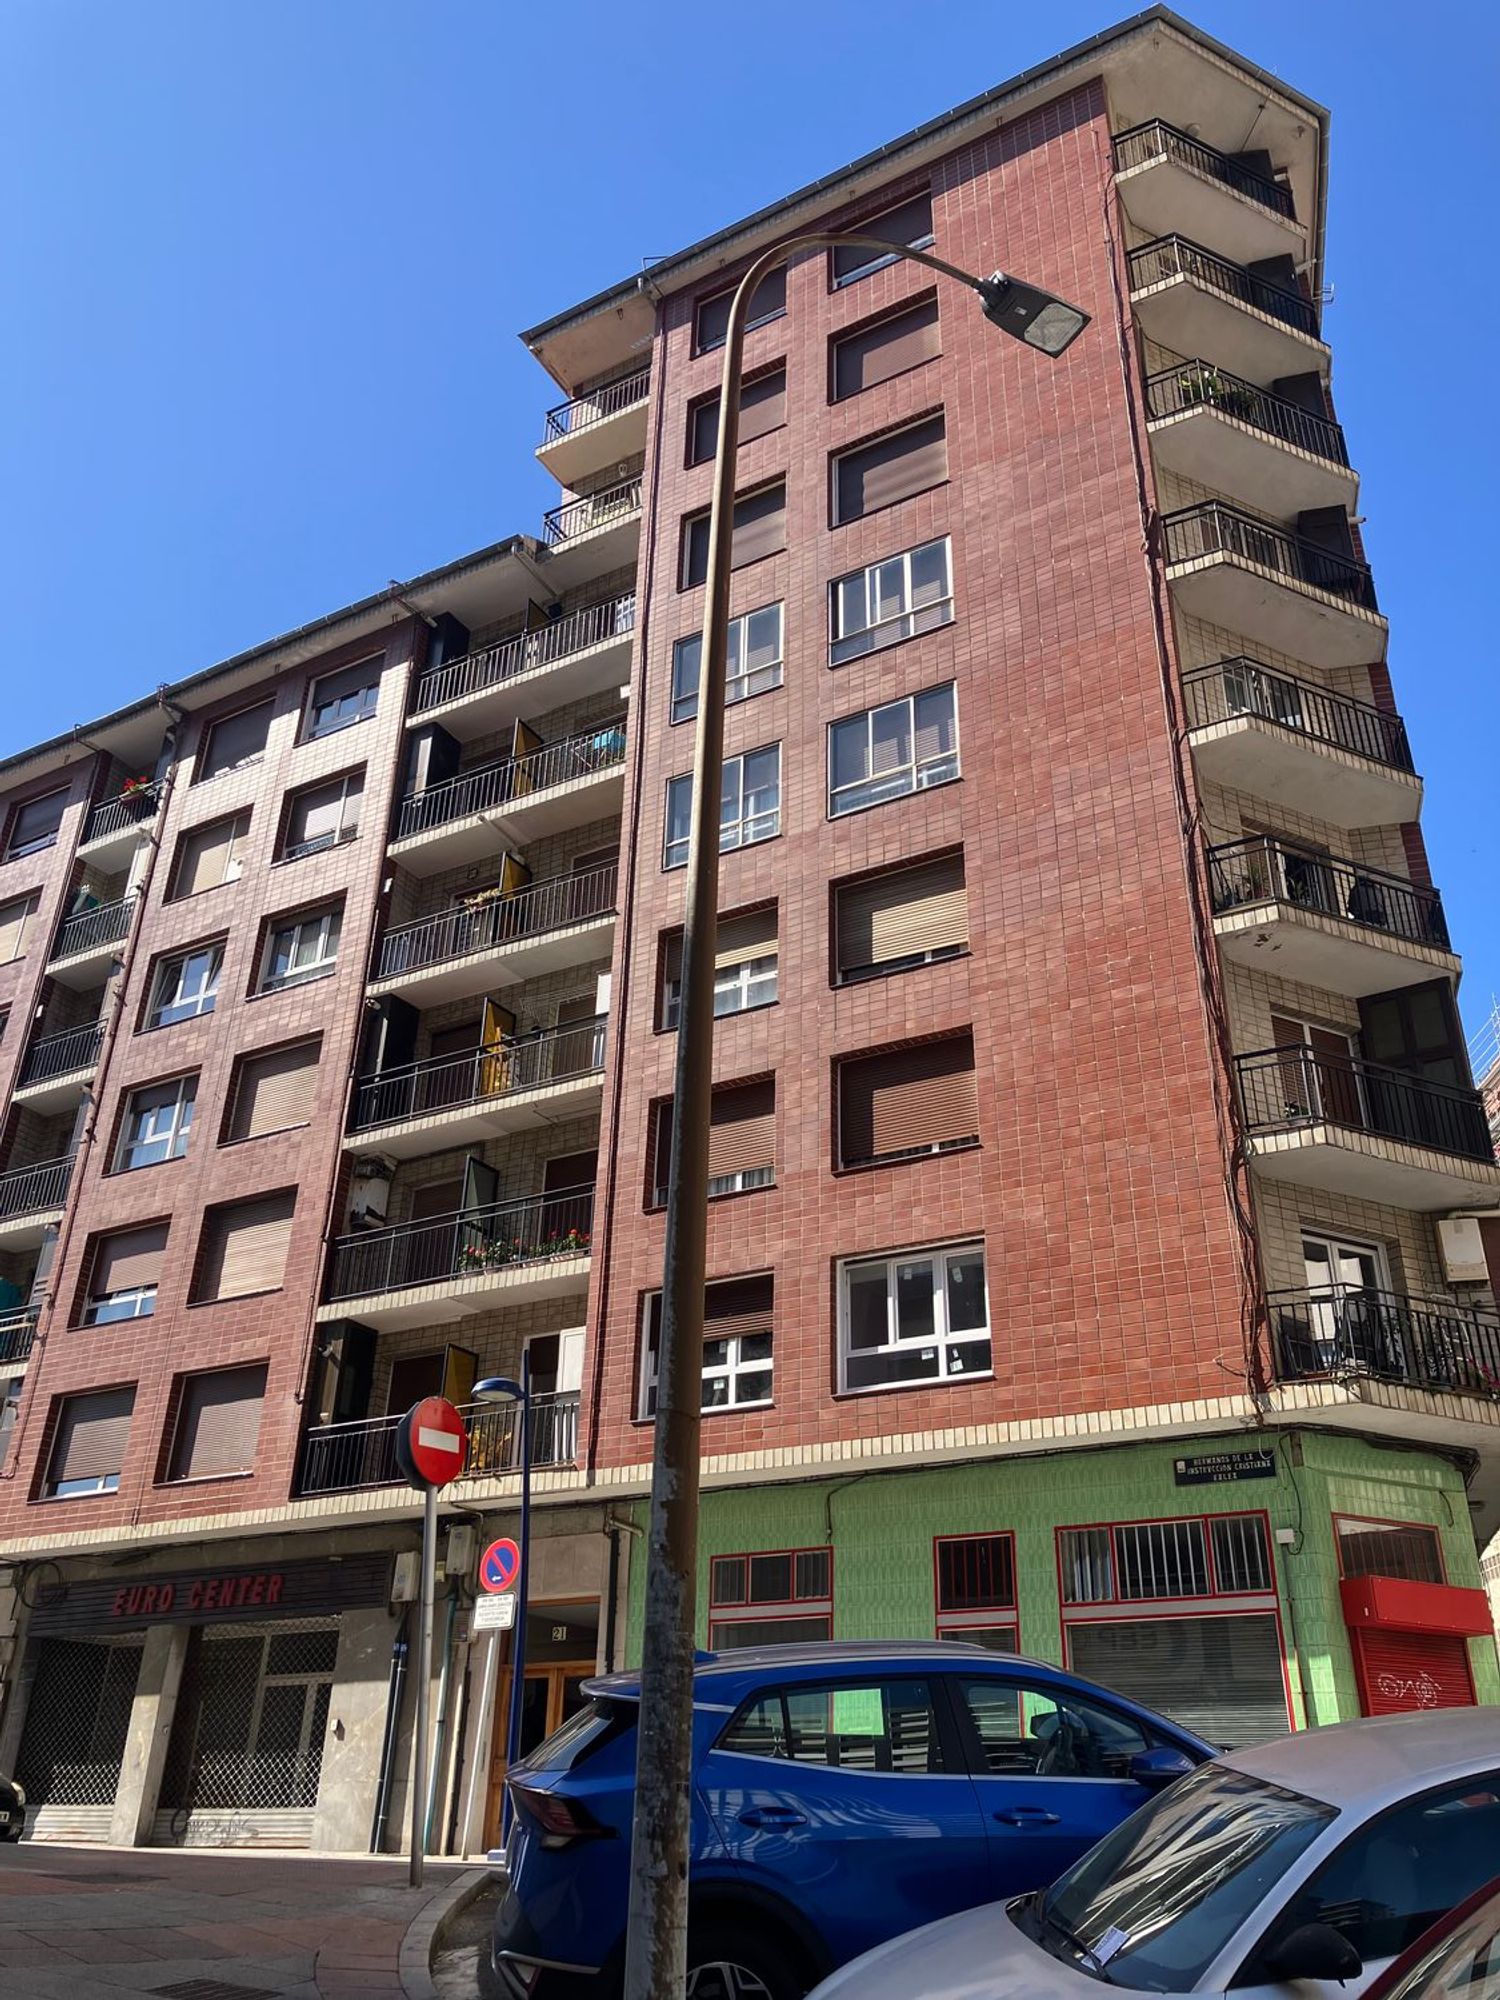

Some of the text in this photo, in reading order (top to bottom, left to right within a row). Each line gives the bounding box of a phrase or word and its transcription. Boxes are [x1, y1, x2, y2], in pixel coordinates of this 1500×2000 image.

[1232, 1454, 1240, 1462] DE
[111, 1574, 285, 1617] EURO CENTER
[553, 1627, 565, 1640] 21
